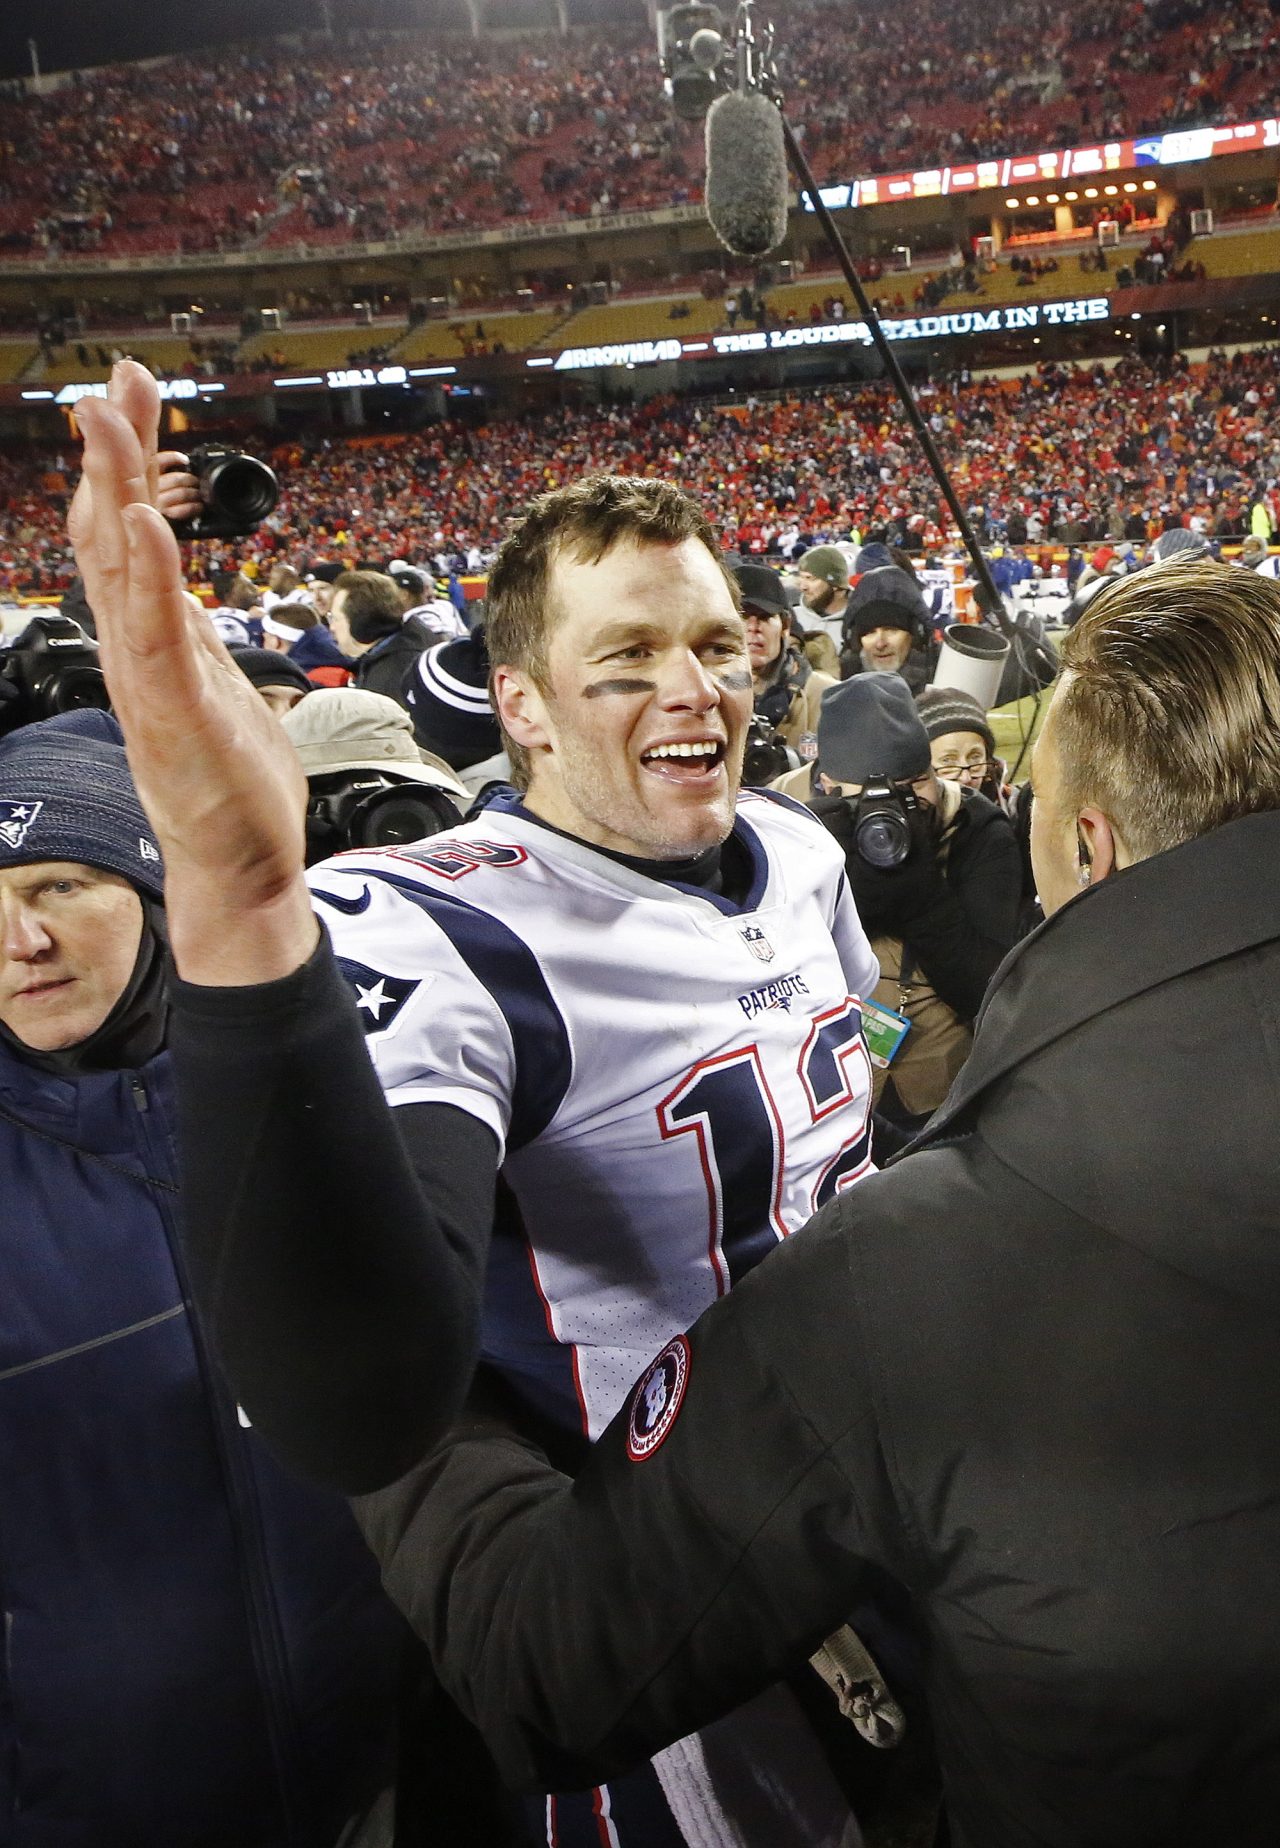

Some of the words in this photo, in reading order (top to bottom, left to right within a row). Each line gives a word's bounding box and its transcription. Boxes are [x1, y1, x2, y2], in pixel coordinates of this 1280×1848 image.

[554, 339, 681, 370] ARROWHEAD
[713, 332, 767, 353] THE
[1005, 306, 1039, 328] IN
[1043, 298, 1109, 323] THE
[737, 974, 811, 1021] PATRIOTS
[655, 996, 875, 1297] 12
